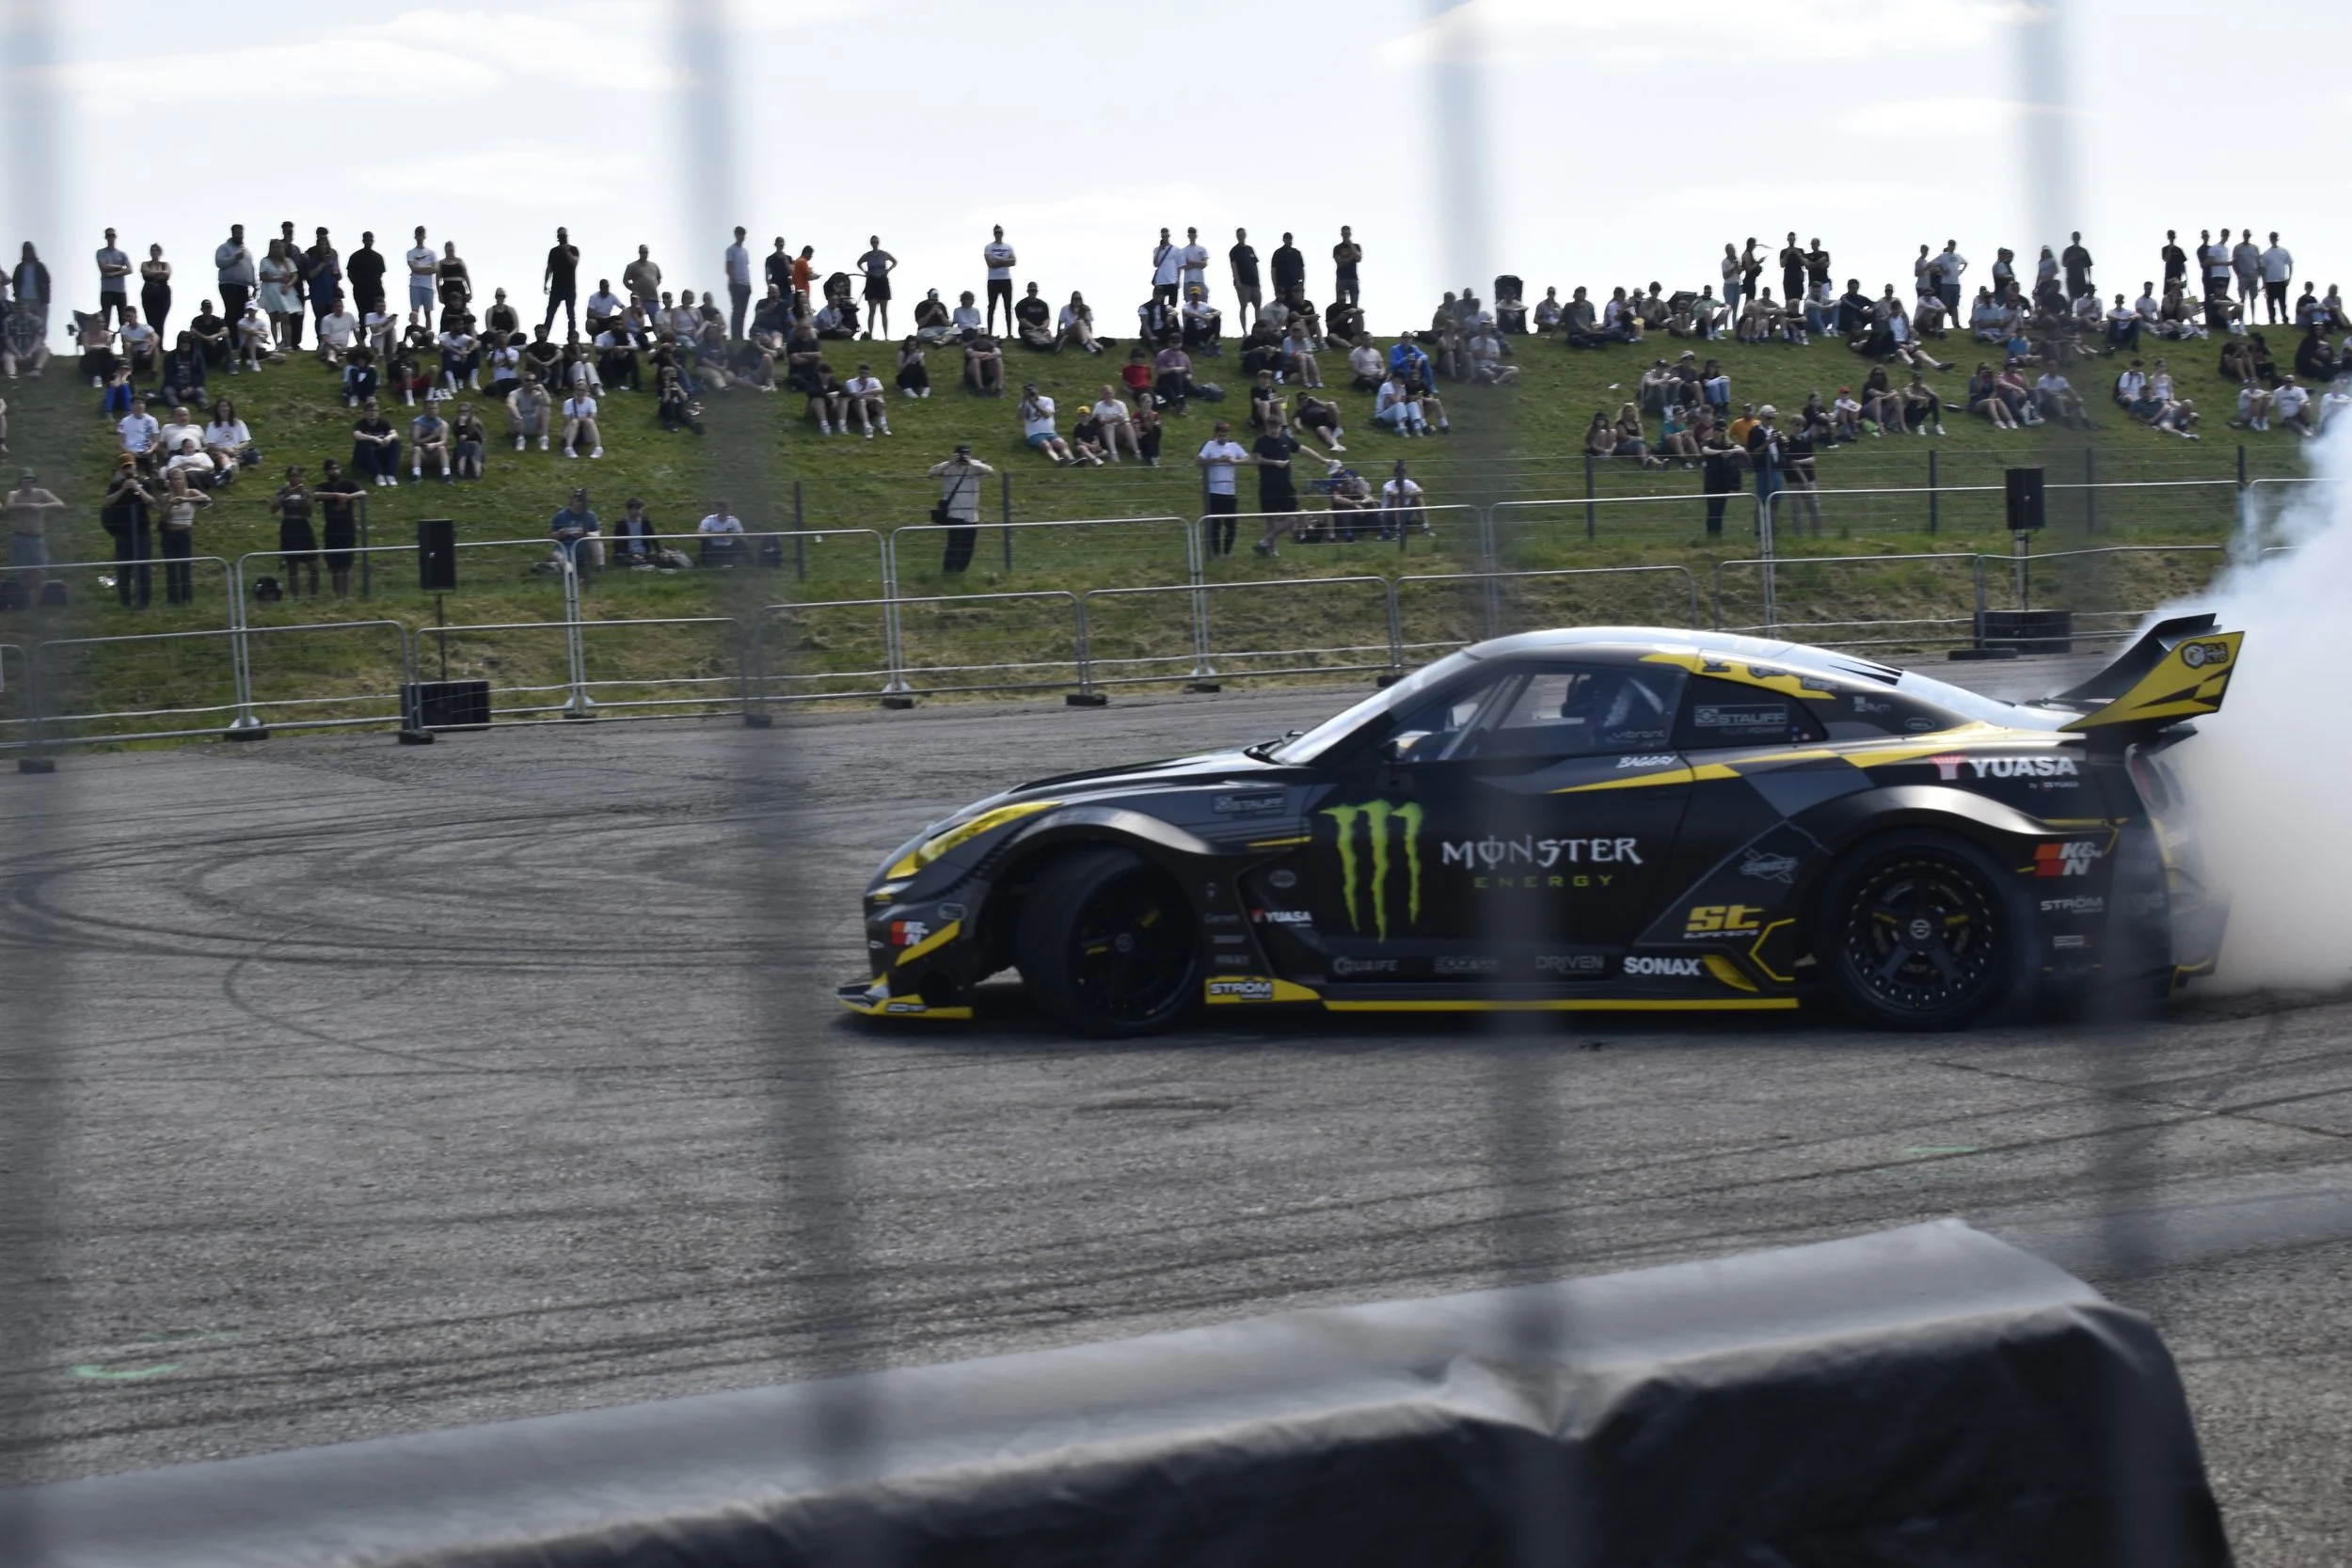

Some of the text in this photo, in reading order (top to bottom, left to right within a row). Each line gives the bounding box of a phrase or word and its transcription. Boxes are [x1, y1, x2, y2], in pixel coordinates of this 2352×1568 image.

[1718, 713, 1786, 723] STAUFF
[1967, 756, 2078, 778] YUASA
[1441, 833, 1644, 870] MONSTER
[1473, 876, 1614, 889] ENERGY
[2040, 895, 2104, 911] STRÖM
[1264, 911, 1312, 923] YUASA
[1535, 955, 1604, 973] DRIVEN
[1623, 956, 1700, 976] SONAX
[1210, 980, 1272, 994] STRÖM
